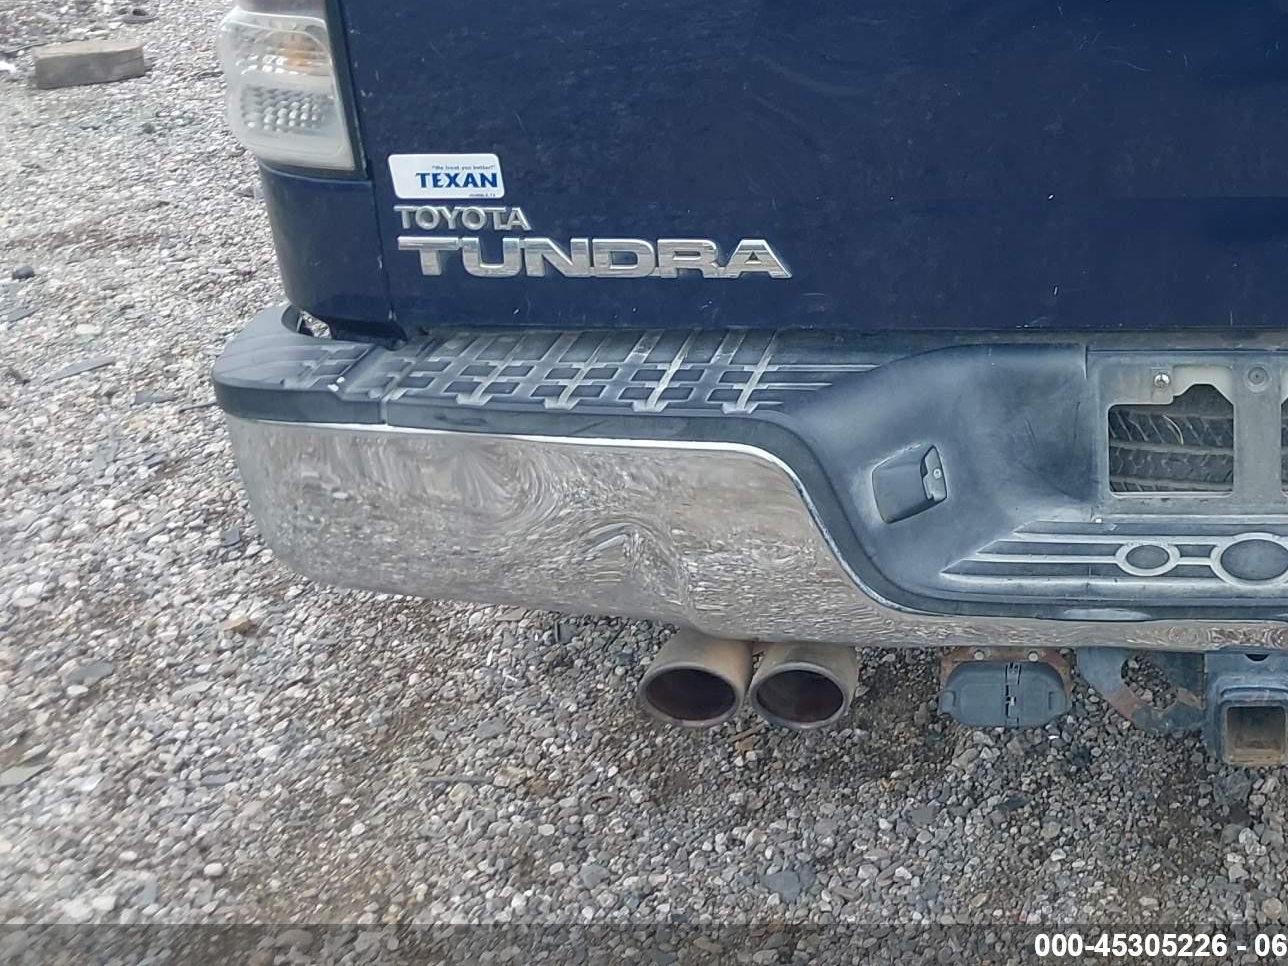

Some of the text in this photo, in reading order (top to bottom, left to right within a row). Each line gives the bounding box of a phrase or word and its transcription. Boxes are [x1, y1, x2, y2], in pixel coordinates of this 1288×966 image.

[415, 172, 498, 189] TEXAN
[393, 204, 533, 232] TOYOTA
[397, 236, 793, 280] TUNDRA
